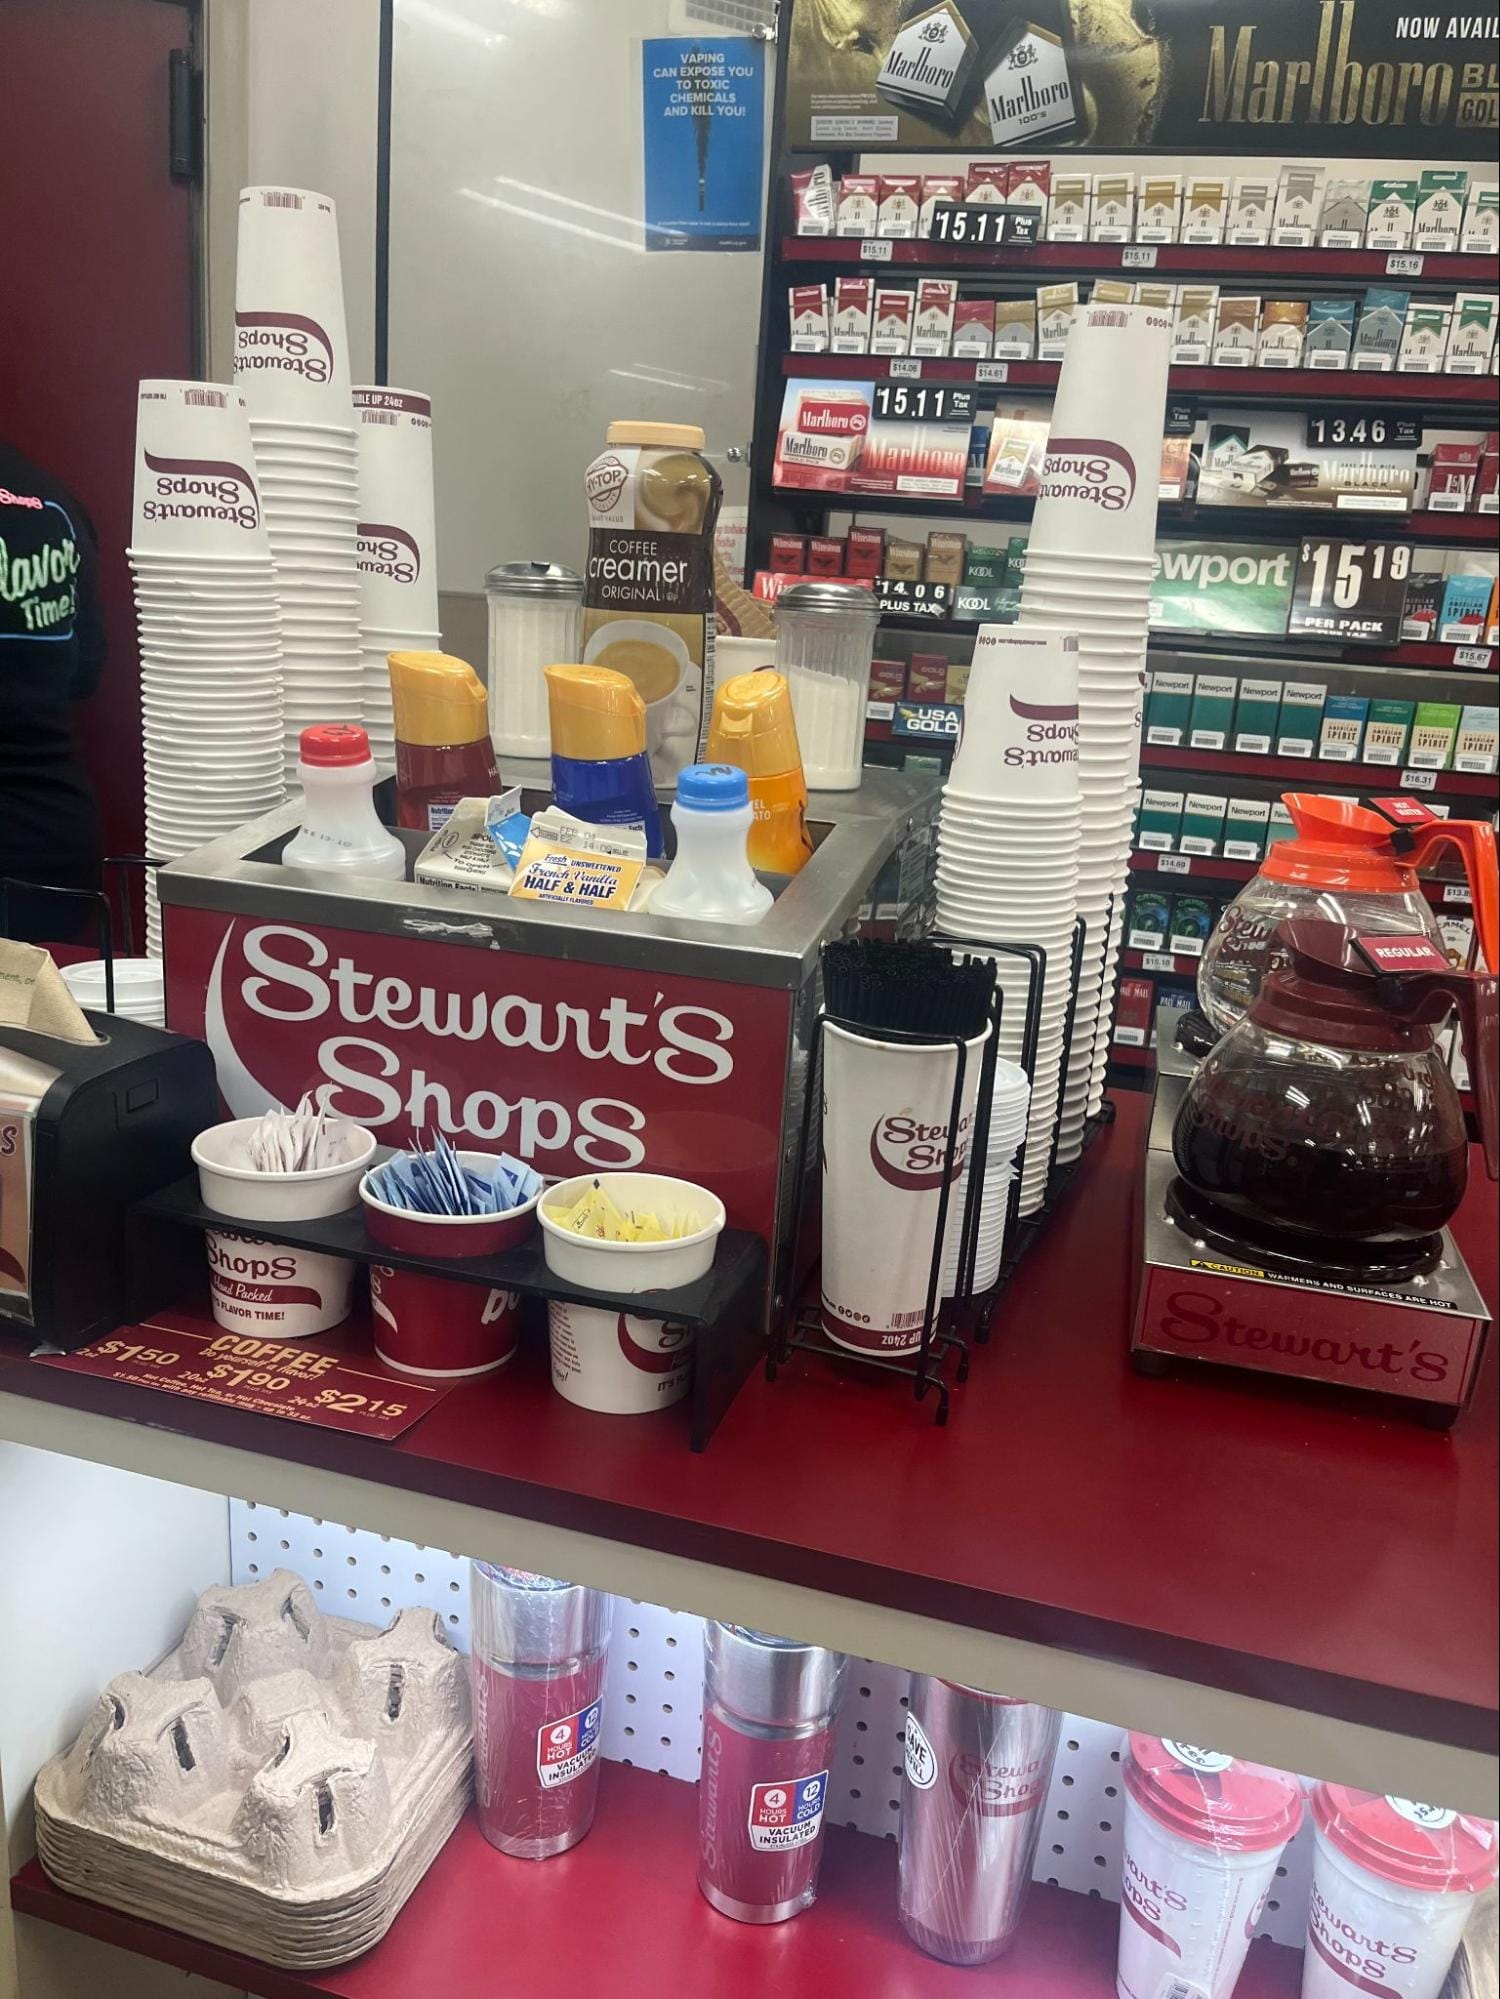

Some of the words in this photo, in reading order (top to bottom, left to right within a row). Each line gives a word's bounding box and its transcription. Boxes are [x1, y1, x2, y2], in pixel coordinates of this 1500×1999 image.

[1396, 17, 1440, 39] NOW
[681, 53, 725, 64] VAPING
[1198, 0, 1454, 125] Marlboro
[653, 67, 677, 78] CAN
[680, 66, 725, 77] EXPOSE
[729, 66, 753, 77] YOU
[884, 47, 954, 89] Marlboro
[676, 80, 691, 90] TO
[695, 80, 730, 90] TOXIC
[670, 93, 736, 103] CHEMICALS
[991, 76, 1069, 123] Marlboro
[664, 106, 688, 117] AND
[691, 105, 714, 116] KILL
[717, 106, 746, 117] YOU!
[936, 211, 1006, 242] $15.11
[1015, 215, 1033, 227] Plus
[1016, 225, 1030, 236] Tax
[862, 245, 888, 256] $15.11
[1124, 251, 1151, 261] $15.11
[1389, 258, 1420, 270] $15.16
[916, 319, 948, 339] Marlboro
[239, 330, 308, 356] Shops
[893, 362, 918, 374] $14.06
[372, 394, 382, 404] UP
[877, 387, 945, 417] $15.11
[953, 392, 971, 401] Plus
[954, 400, 968, 408] Tax
[802, 409, 848, 428] Marlboro
[1312, 419, 1386, 443] $13.46
[785, 437, 828, 458] Marlboro
[867, 426, 965, 475] Marlboro
[1043, 456, 1110, 484] Shops
[1320, 452, 1410, 482] Marlboro
[157, 477, 240, 504] Shops
[1344, 480, 1389, 488] BLACK
[143, 500, 257, 530] Stewart's
[773, 537, 803, 550] Winston
[851, 532, 881, 544] Winston
[931, 537, 961, 549] Winston
[609, 540, 657, 556] COFFEE
[811, 541, 841, 554] Winston
[589, 556, 688, 583] creamer
[969, 566, 994, 578] KOOL
[1152, 553, 1291, 589] ewport
[601, 585, 660, 601] ORIGINAL
[880, 601, 910, 612] PLUS
[913, 602, 936, 614] TAX
[957, 597, 991, 611] KOOL
[1305, 617, 1334, 629] PER
[1339, 618, 1383, 632] PACK
[1459, 651, 1488, 662] $15.67
[1155, 679, 1190, 690] Newport
[1198, 682, 1233, 693] Newport
[1243, 686, 1278, 697] Newport
[1286, 689, 1322, 700] Newport
[918, 708, 958, 722] USA
[907, 720, 959, 733] GOLD
[1327, 731, 1355, 741] SPIRIT
[1371, 735, 1401, 744] SPIRIT
[1418, 738, 1448, 749] SPIRIT
[1463, 742, 1493, 752] SPIRIT
[1405, 774, 1432, 785] $16.31
[1145, 797, 1179, 808] Newport
[1189, 800, 1223, 812] Newport
[1231, 806, 1266, 817] Newport
[544, 854, 567, 865] Fresh
[571, 860, 622, 872] UNSWEETENED
[529, 864, 568, 880] French
[574, 869, 618, 885] Vanilla
[524, 876, 559, 892] HALF
[564, 881, 575, 894] &
[579, 882, 616, 898] HALF
[539, 894, 569, 903] ARTIFICIALLY
[569, 897, 594, 906] FLAVORED
[1375, 947, 1436, 958] REGULAR
[241, 924, 734, 1085] Stewart's
[314, 1035, 645, 1168] Shops
[205, 1233, 296, 1280] Shops
[236, 1283, 274, 1302] Packed
[1211, 1263, 1260, 1276] CAUTION
[1267, 1272, 1320, 1287] WARMERS
[1323, 1281, 1344, 1291] AND
[1347, 1286, 1403, 1300] SURFACES
[1405, 1295, 1426, 1305] ARE
[1429, 1299, 1452, 1309] HOT
[221, 1301, 252, 1318] FLAVOR
[255, 1311, 285, 1320] TIME!
[1160, 1290, 1449, 1382] Stewart's
[210, 1335, 340, 1374] COFFEE
[198, 1348, 213, 1356] Do
[214, 1350, 268, 1369] yourself
[276, 1364, 321, 1380] flavor!
[555, 1728, 566, 1741] 4
[547, 1742, 573, 1754] HOURS
[547, 1748, 571, 1762] HOT
[806, 1784, 819, 1798] 12
[769, 1792, 780, 1805] 4
[760, 1808, 787, 1816] HOURS
[797, 1803, 820, 1820] COLD
[758, 1814, 786, 1824] HOT
[759, 1825, 815, 1845] INSULATED
[769, 1820, 811, 1837] VACUUM
[1312, 1882, 1418, 1964] tewart's
